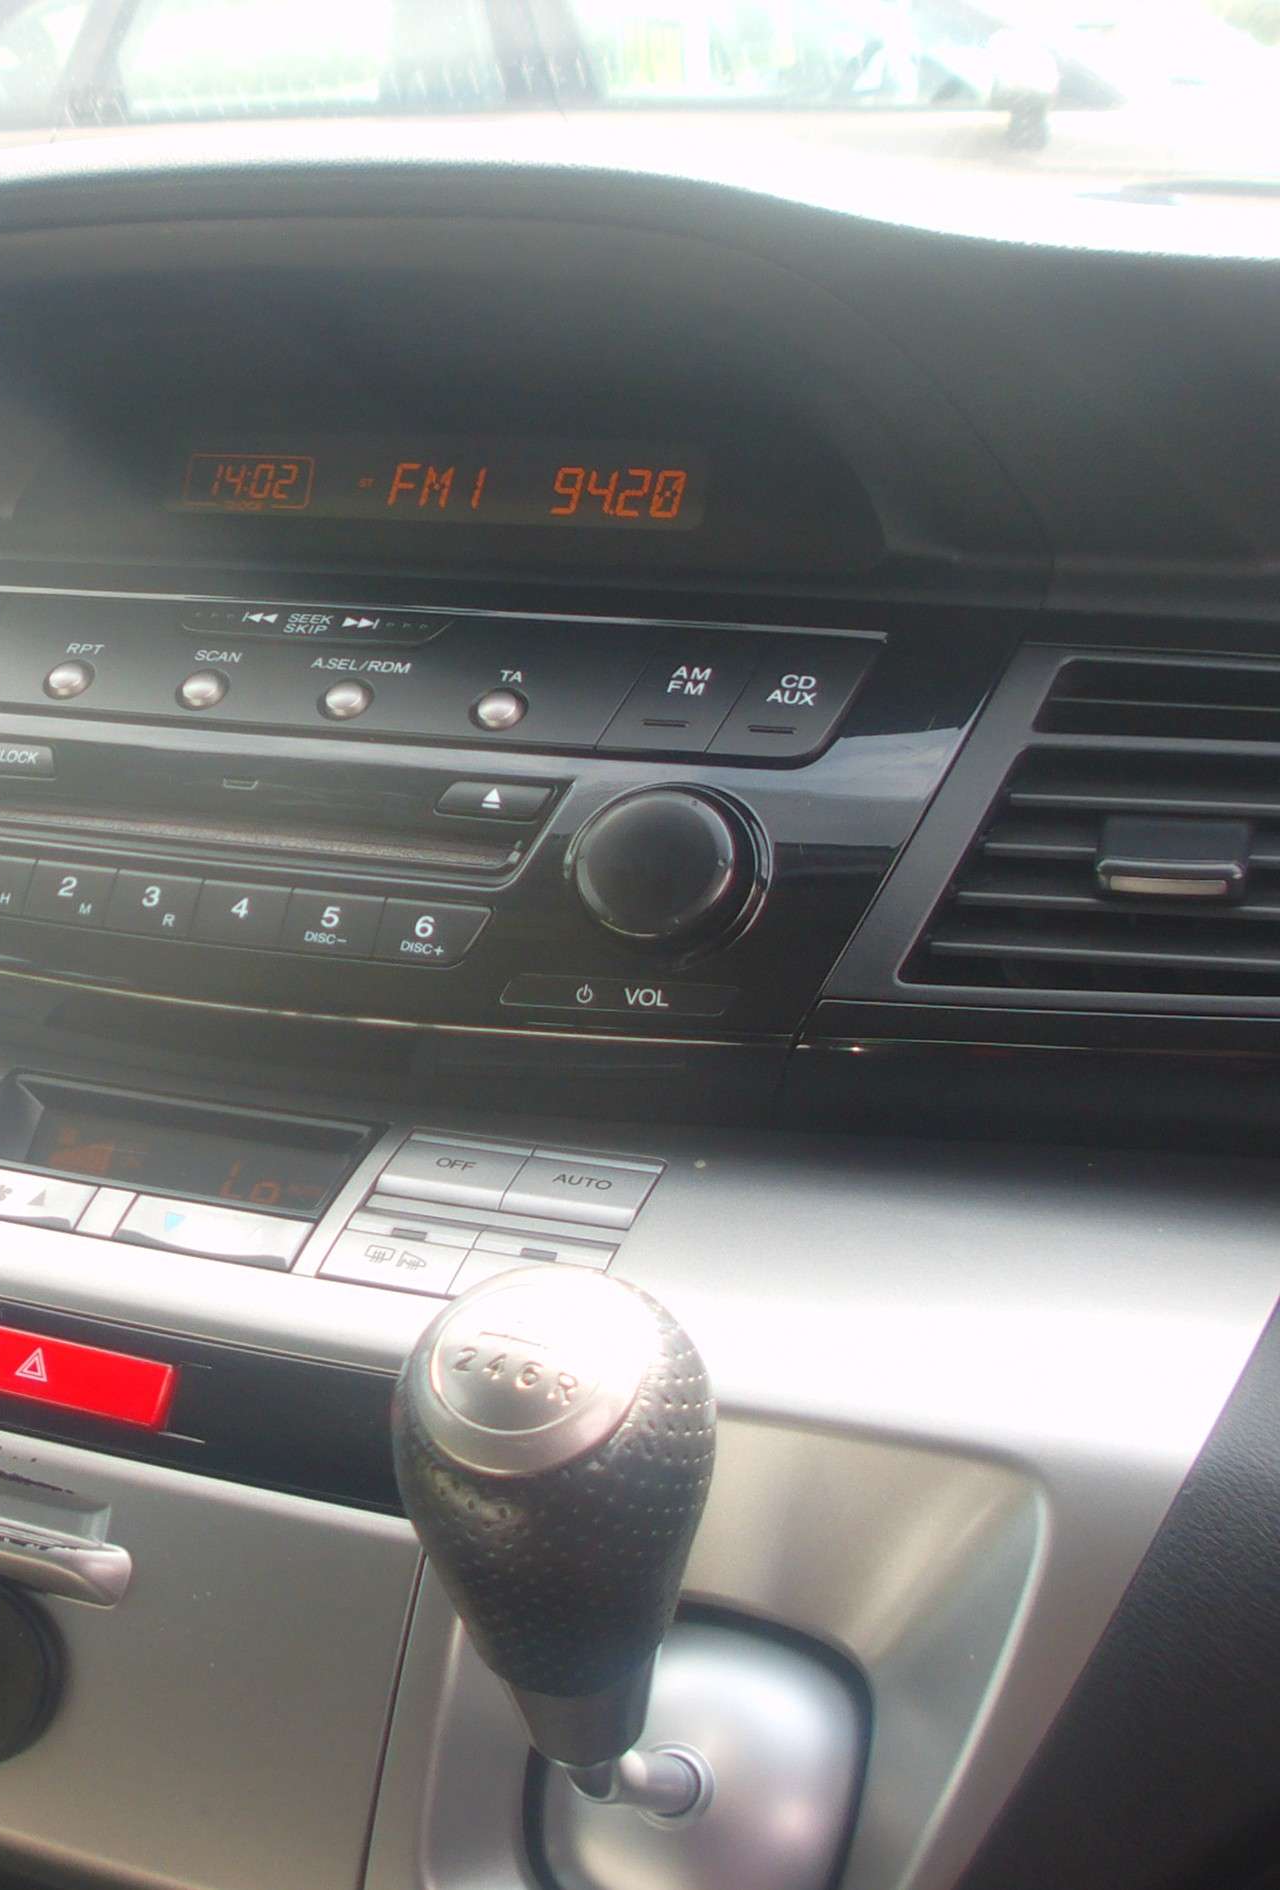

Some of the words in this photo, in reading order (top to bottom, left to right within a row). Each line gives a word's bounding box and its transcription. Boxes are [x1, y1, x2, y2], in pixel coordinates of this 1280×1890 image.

[210, 463, 298, 499] 14:02
[287, 612, 334, 627] SEEK
[283, 624, 329, 636] SKIP
[66, 642, 106, 656] RPT
[193, 649, 243, 665] SCAN
[499, 668, 524, 684] TA
[671, 664, 713, 682] AM
[780, 673, 817, 691] CD
[666, 679, 706, 697] FM
[765, 688, 818, 707] AUX
[57, 876, 79, 898] 2
[0, 891, 11, 904] H
[141, 885, 161, 908] 3
[78, 902, 93, 916] M
[230, 897, 250, 919] 4
[320, 905, 342, 929] 5
[161, 912, 176, 928] R
[413, 914, 436, 939] 6
[623, 987, 670, 1008] VOL
[436, 1157, 477, 1172] OFF
[552, 1173, 612, 1191] AUTO
[452, 1346, 479, 1372] 2
